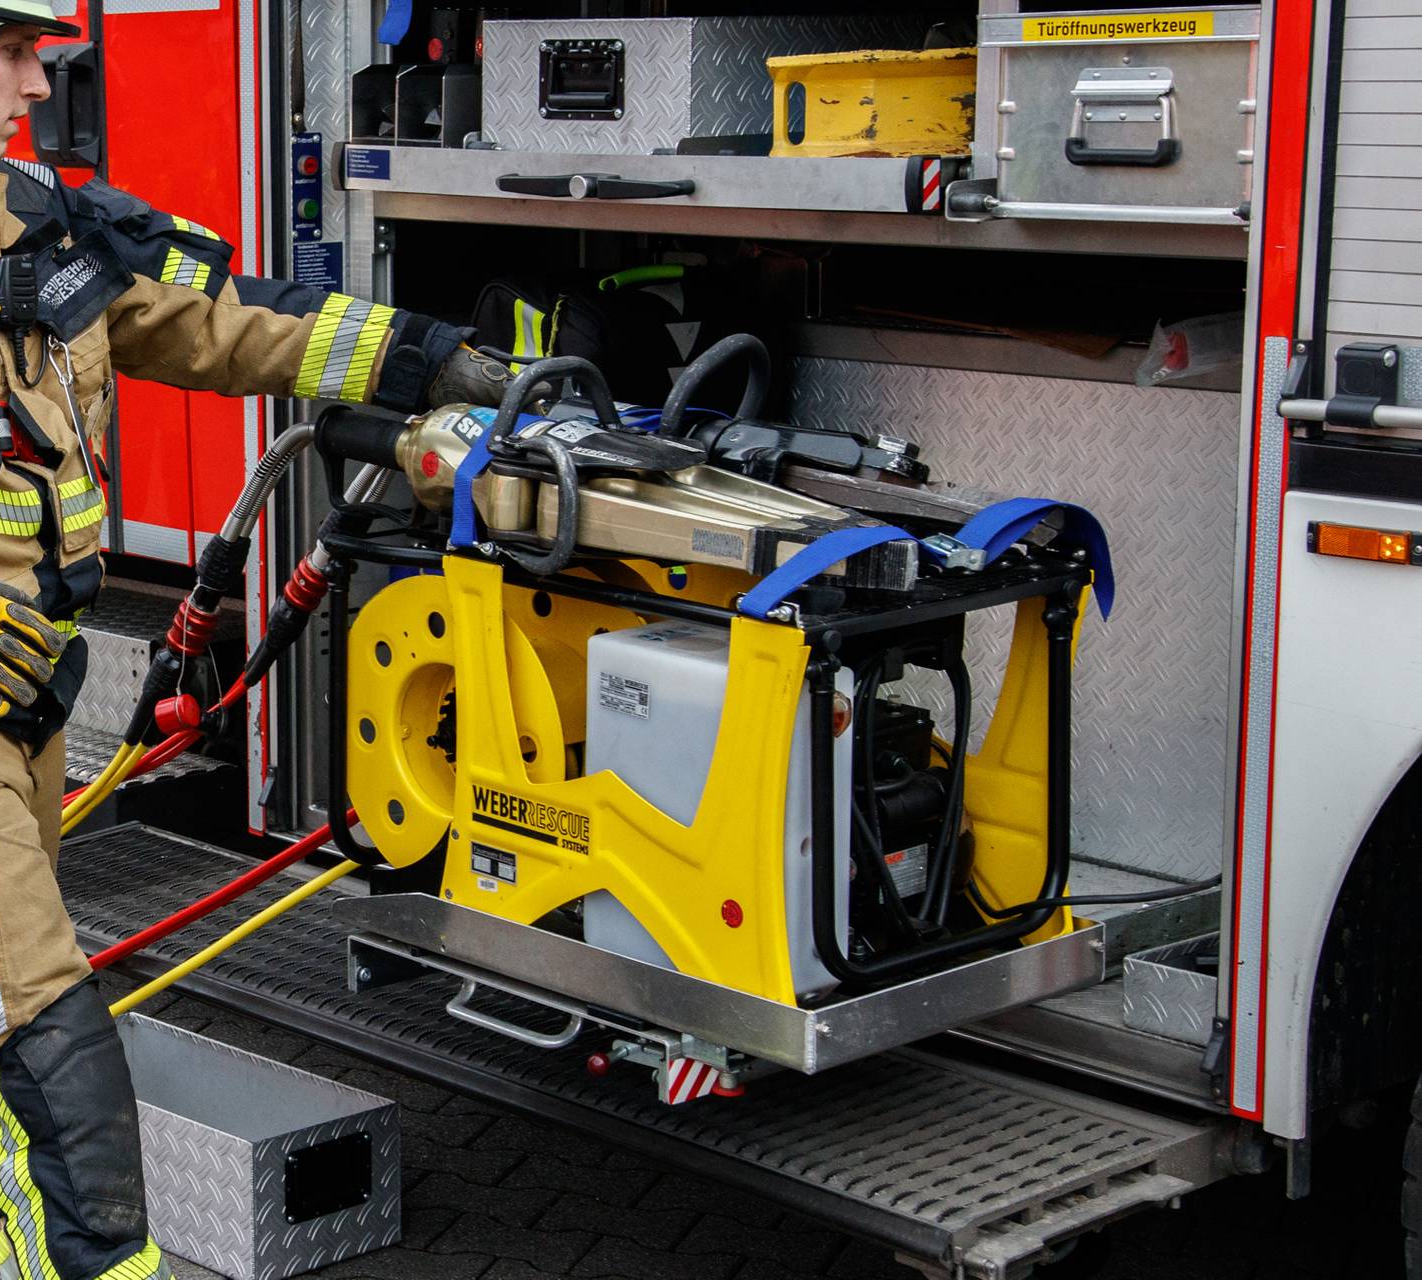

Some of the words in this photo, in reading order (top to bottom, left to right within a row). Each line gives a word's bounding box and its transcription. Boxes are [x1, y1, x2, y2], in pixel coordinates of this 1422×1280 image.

[1037, 18, 1197, 38] Türöffnungswerkzeug
[457, 416, 484, 440] SP
[562, 838, 589, 856] SYSTEMS
